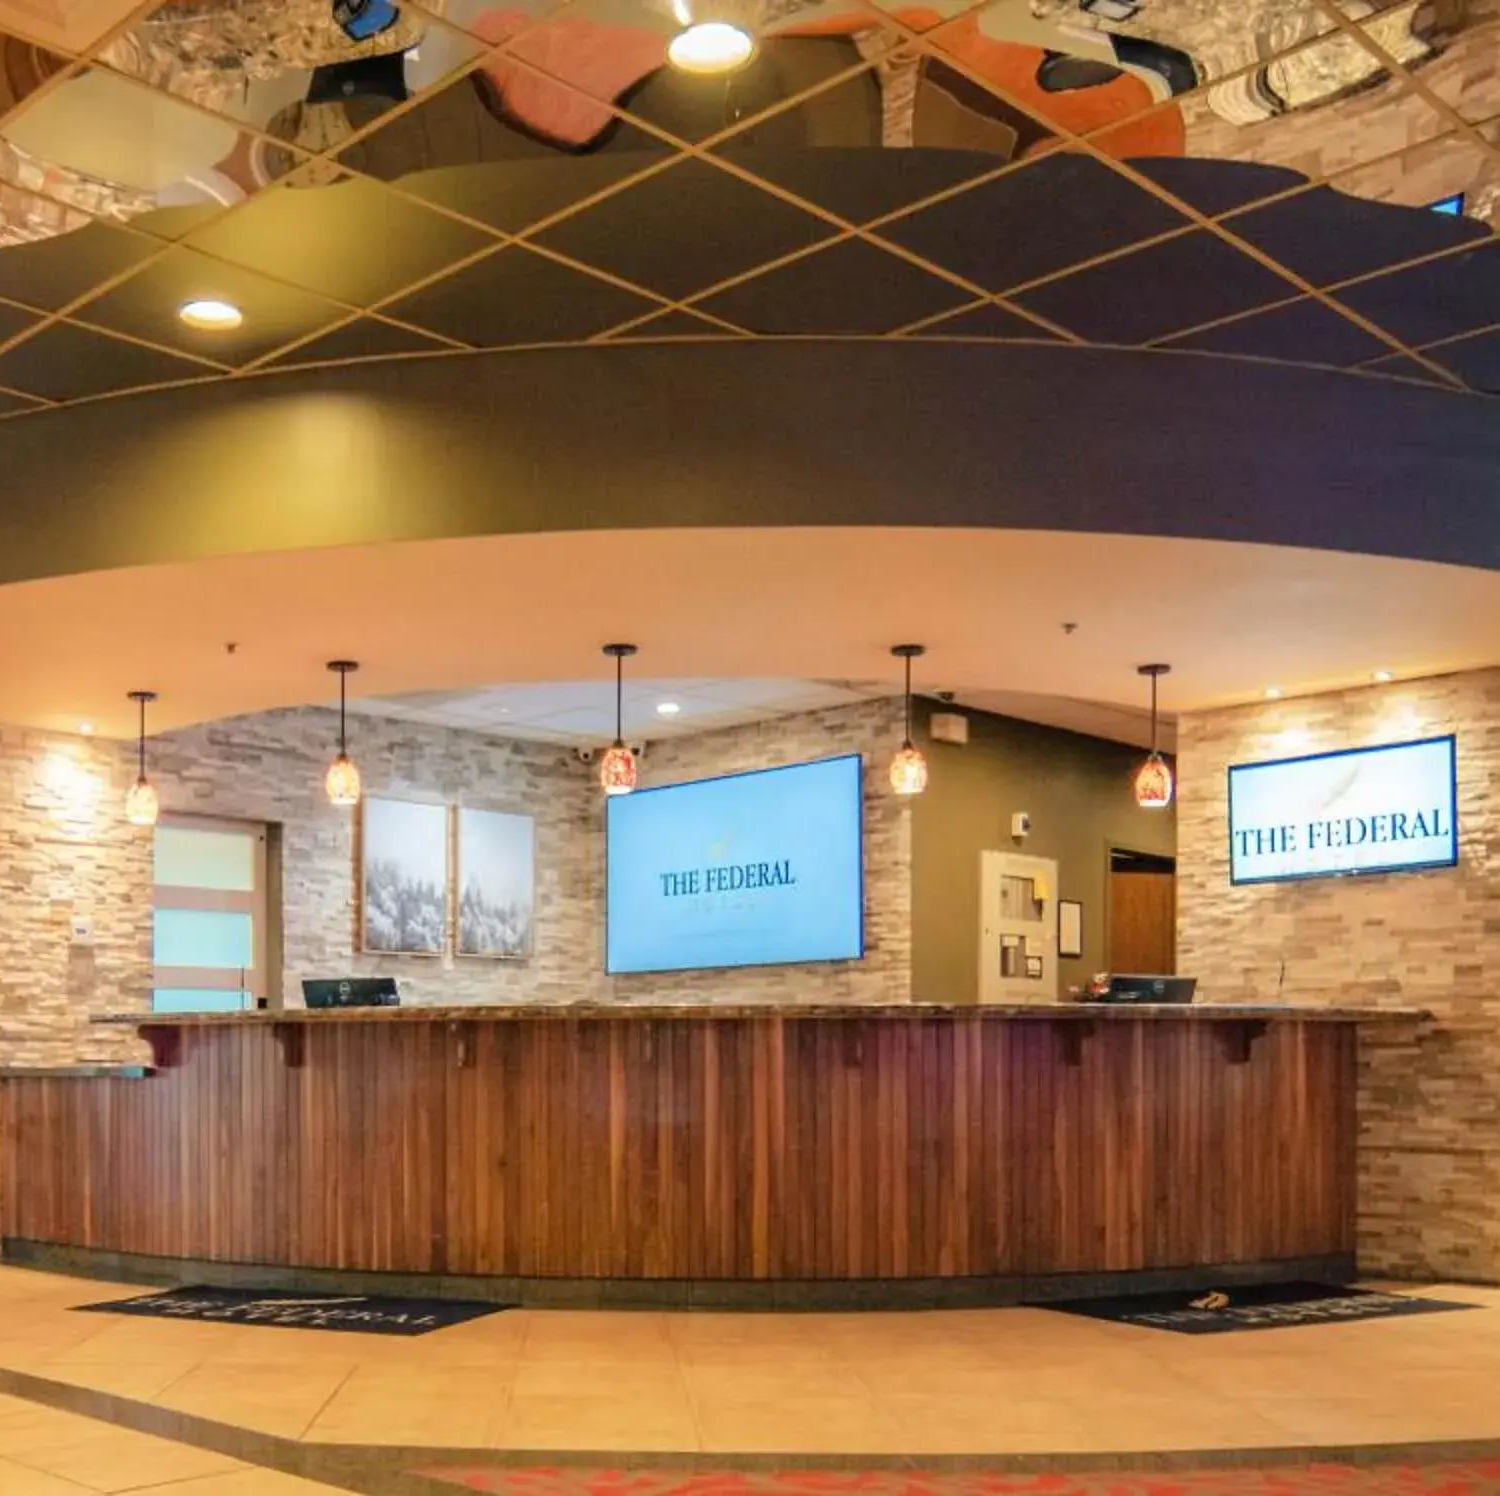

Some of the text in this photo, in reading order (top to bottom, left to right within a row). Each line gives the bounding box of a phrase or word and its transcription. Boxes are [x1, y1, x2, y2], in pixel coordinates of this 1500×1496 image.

[1236, 808, 1449, 857] THE FEDERAL
[660, 859, 796, 896] THE FEDERAL
